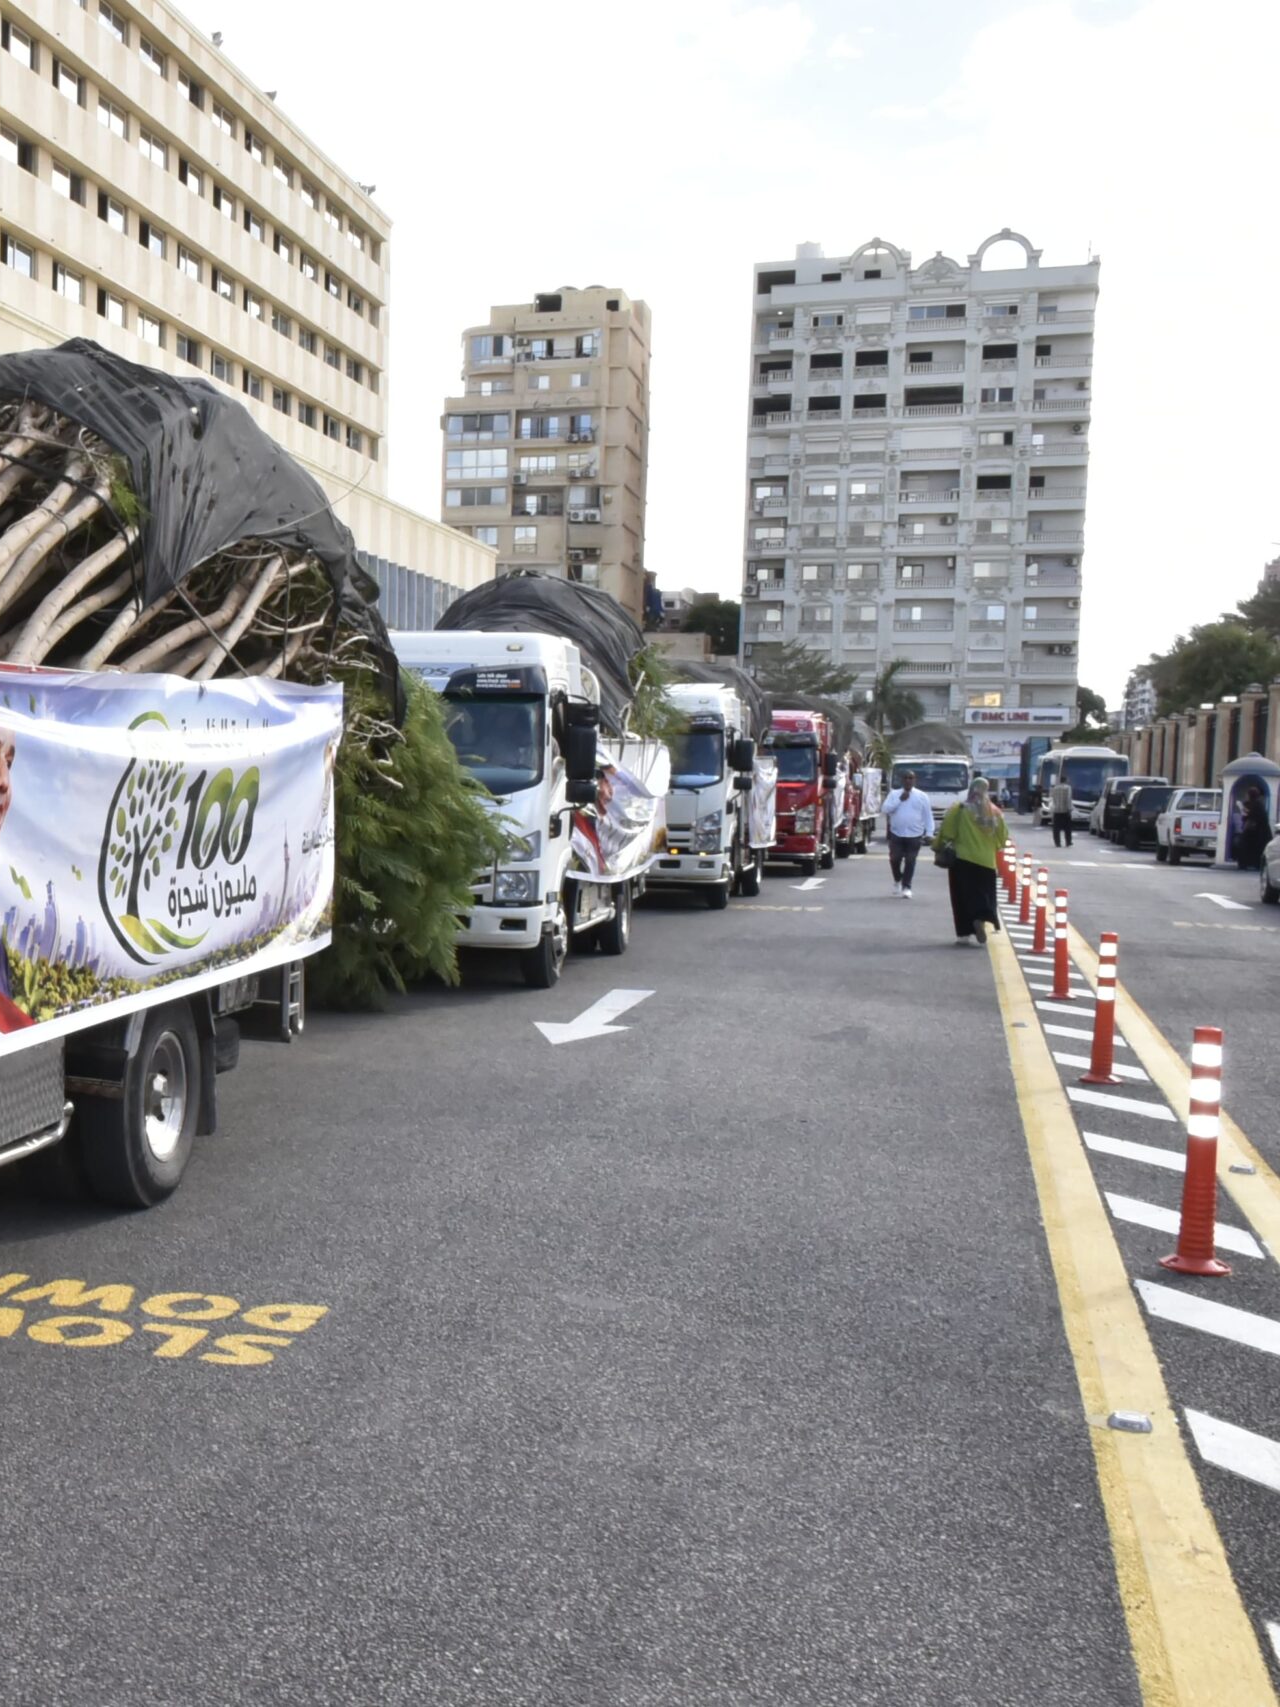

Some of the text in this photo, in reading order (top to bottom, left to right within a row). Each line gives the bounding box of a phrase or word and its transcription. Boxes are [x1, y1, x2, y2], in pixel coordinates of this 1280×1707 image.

[176, 765, 260, 870] 100
[1192, 821, 1217, 830] NIS
[167, 864, 257, 929] مليون شجرة
